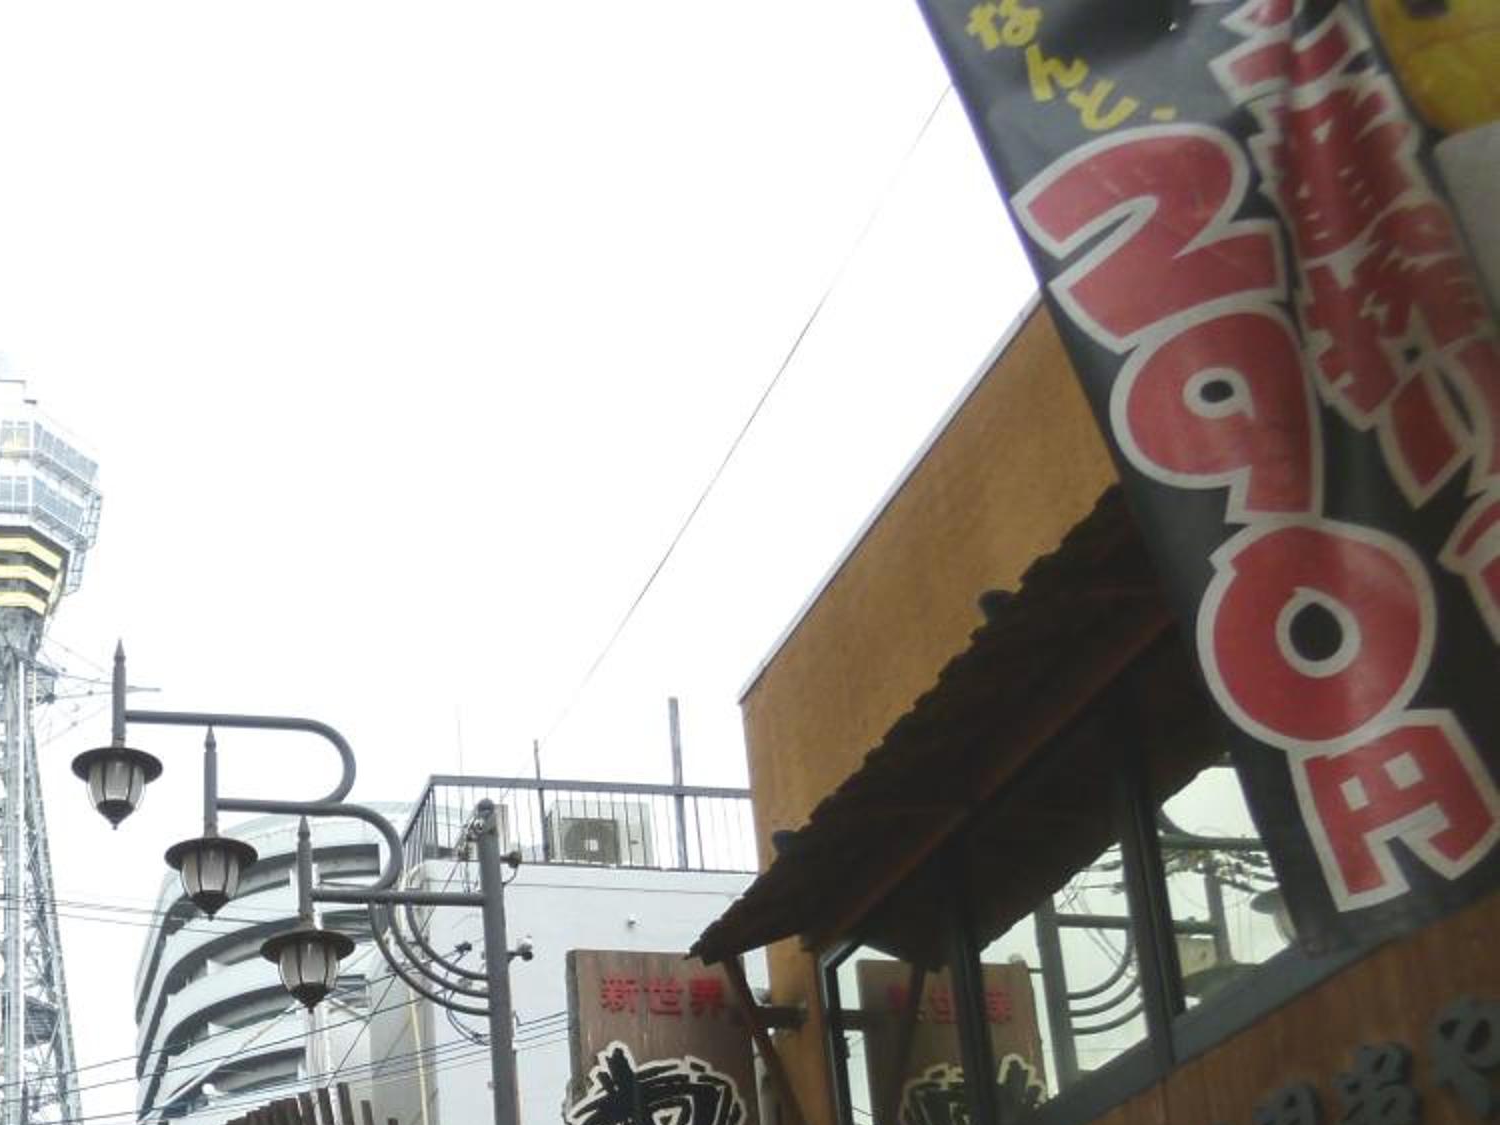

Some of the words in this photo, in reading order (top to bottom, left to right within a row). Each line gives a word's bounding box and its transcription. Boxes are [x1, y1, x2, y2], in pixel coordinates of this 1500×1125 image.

[1011, 125, 1498, 911] 290円
[601, 974, 725, 1017] 新世界
